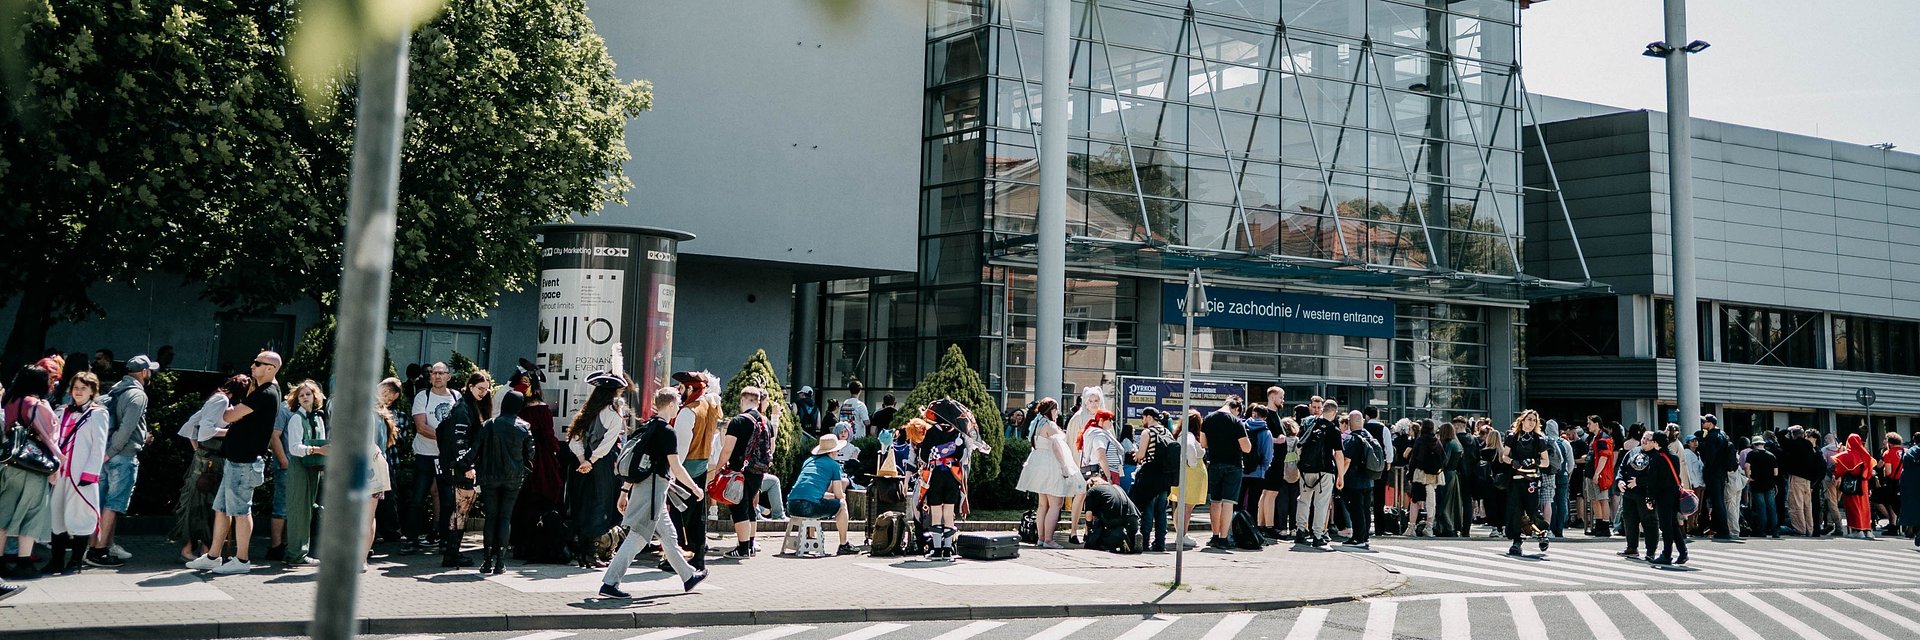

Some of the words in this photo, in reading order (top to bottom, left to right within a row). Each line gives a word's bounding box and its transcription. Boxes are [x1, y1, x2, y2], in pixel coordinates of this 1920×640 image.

[553, 247, 562, 255] City
[563, 247, 592, 256] Marketing
[542, 278, 560, 287] Event
[541, 291, 561, 302] space
[557, 301, 575, 310] limits
[1176, 298, 1225, 313] wcie
[1228, 300, 1292, 318] zachodnie
[1295, 303, 1301, 319] /
[1302, 308, 1341, 322] western
[1343, 312, 1384, 324] entrance
[1128, 384, 1157, 396] PYRKON
